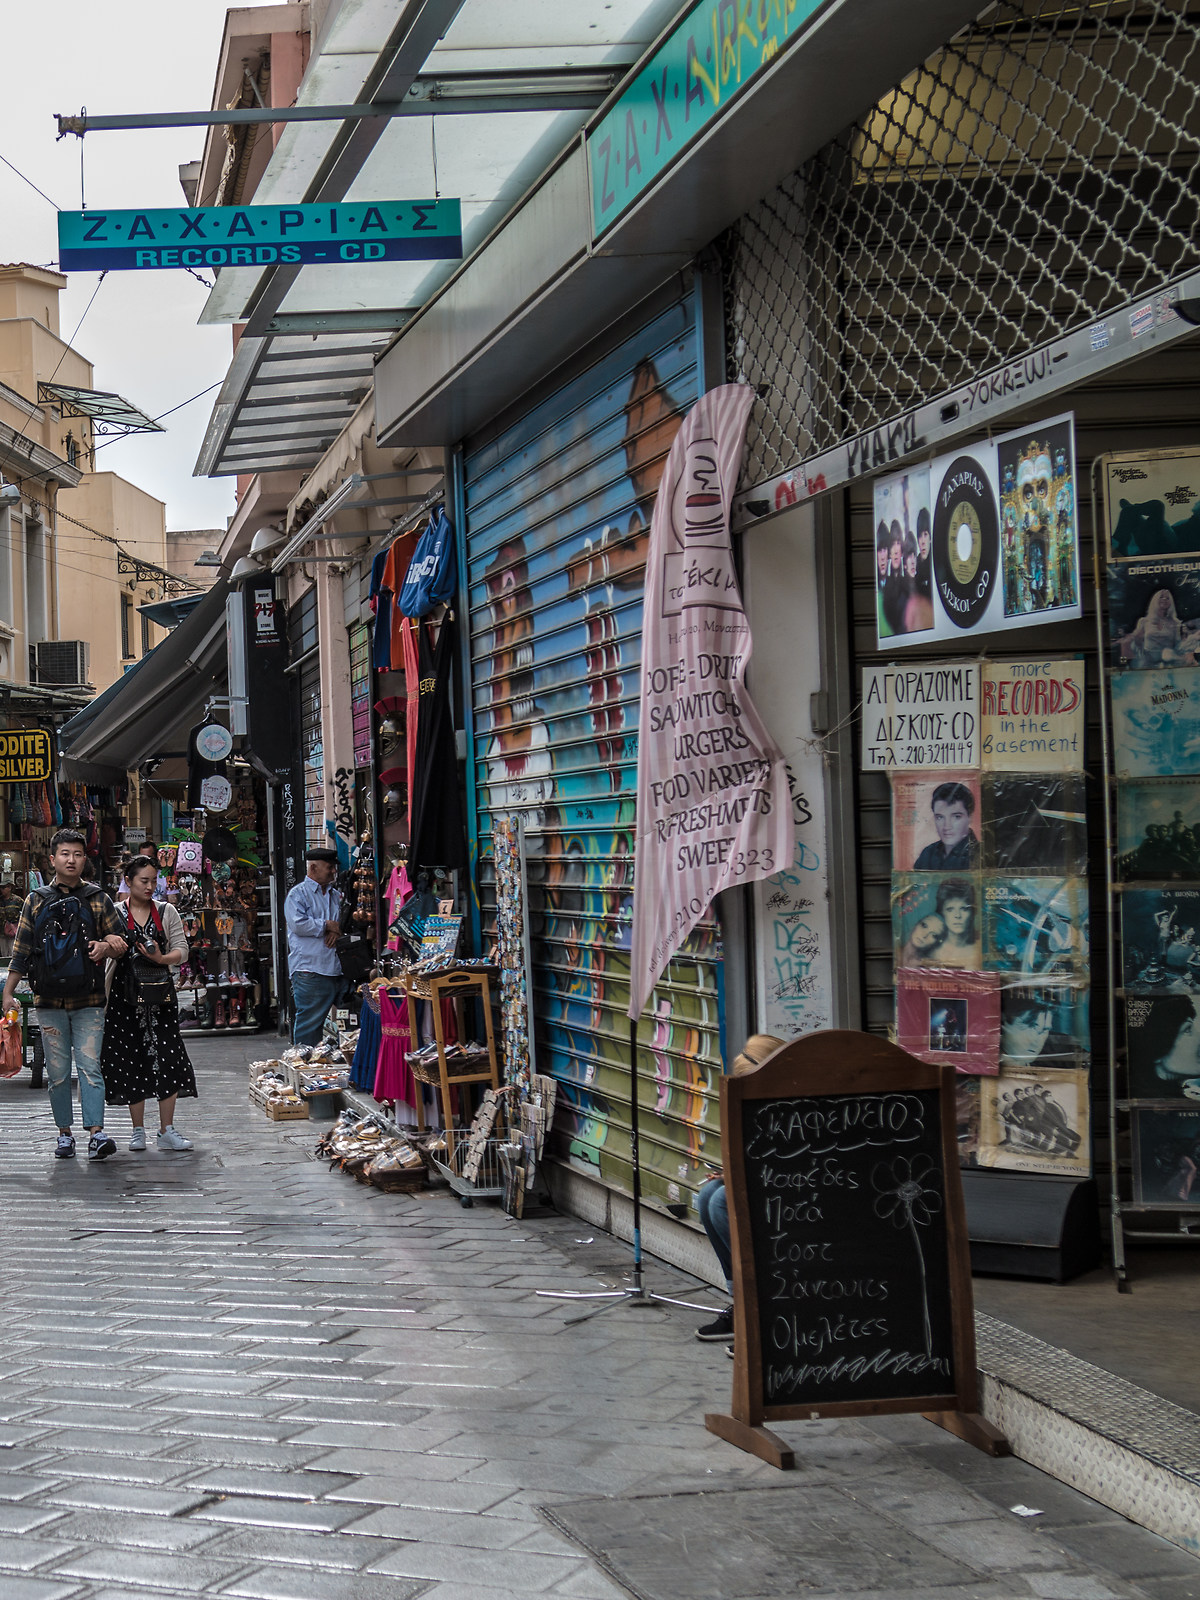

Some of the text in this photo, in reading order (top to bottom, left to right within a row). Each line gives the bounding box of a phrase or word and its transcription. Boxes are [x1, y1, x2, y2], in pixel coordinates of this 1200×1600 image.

[136, 245, 301, 267] RECORDS
[340, 243, 386, 260] CD
[976, 570, 990, 599] CD
[1010, 662, 1052, 678] more
[866, 669, 974, 705] ΑΓΟΡΑΖΟΥΜΕ
[982, 678, 1082, 716] RECORDS
[1151, 689, 1189, 706] MADONNA
[952, 712, 975, 740] CD
[1001, 718, 1051, 733] in the
[985, 887, 1008, 895] 2001
